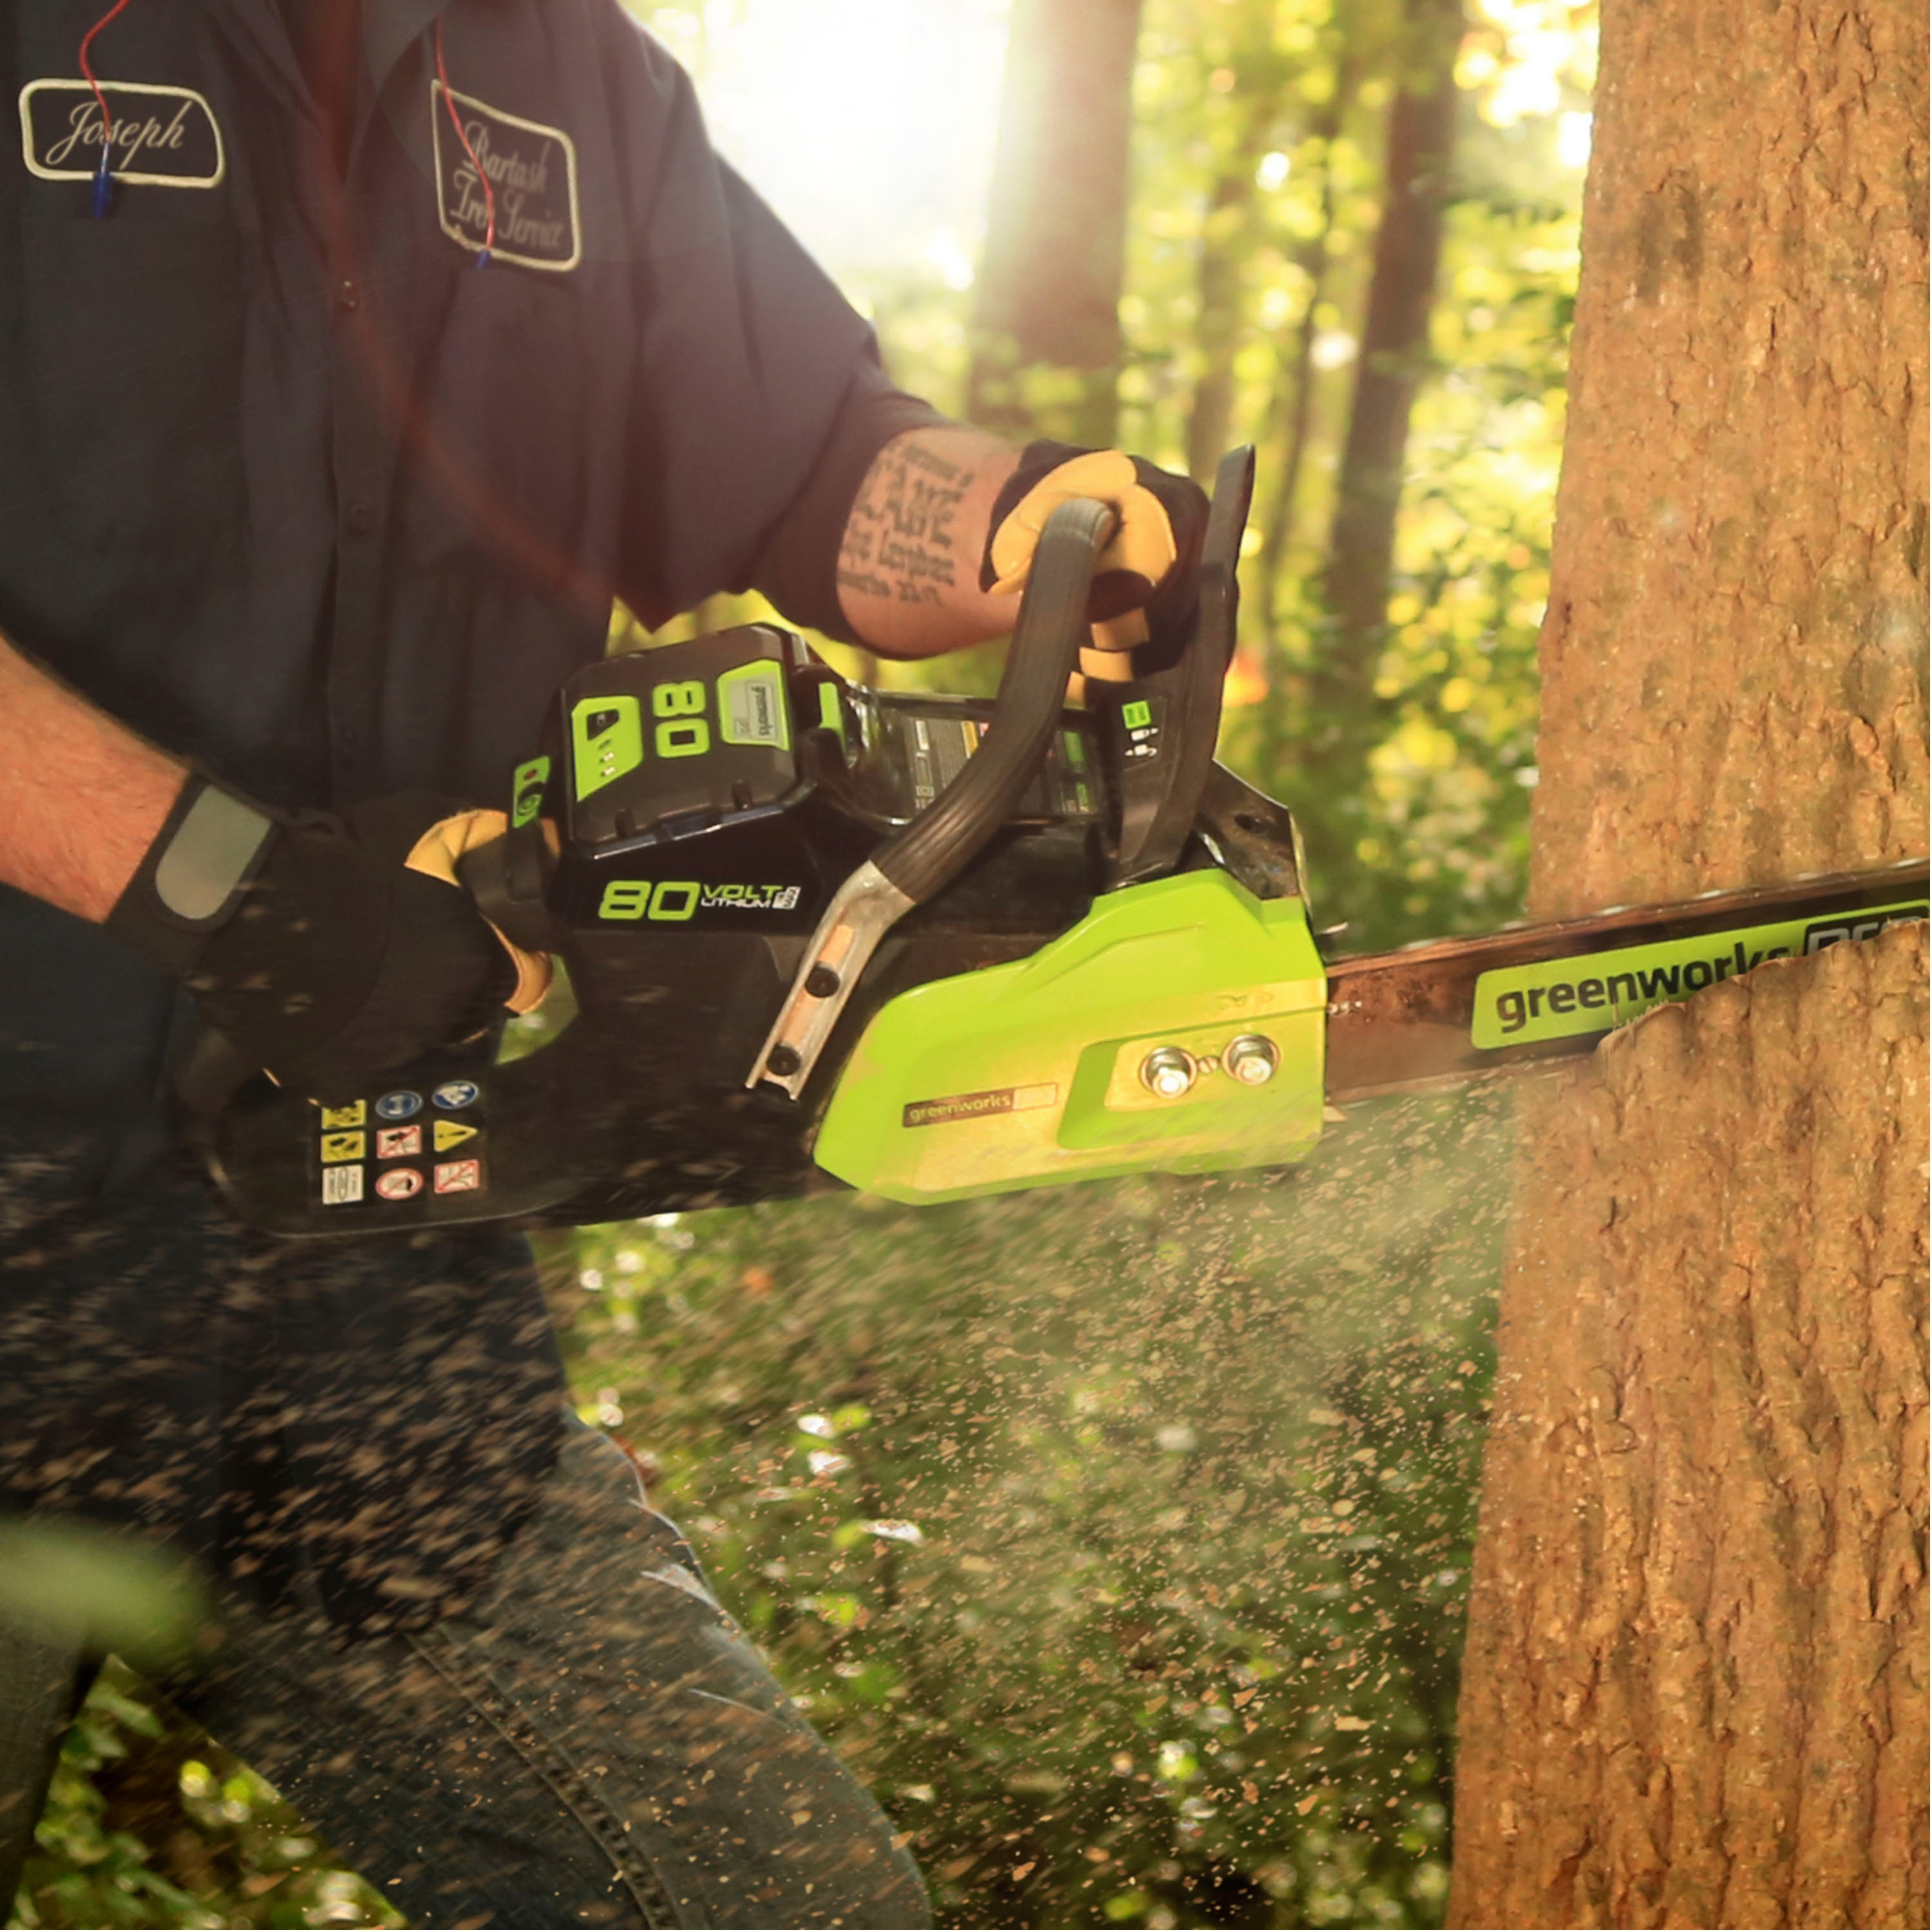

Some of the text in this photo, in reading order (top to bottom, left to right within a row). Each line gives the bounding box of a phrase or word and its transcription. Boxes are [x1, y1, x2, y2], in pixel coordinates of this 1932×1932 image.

[45, 100, 193, 170] Joseph
[652, 679, 710, 759] 80
[598, 880, 701, 920] 80
[703, 884, 782, 900] VOLT
[909, 1094, 1012, 1124] greenworks
